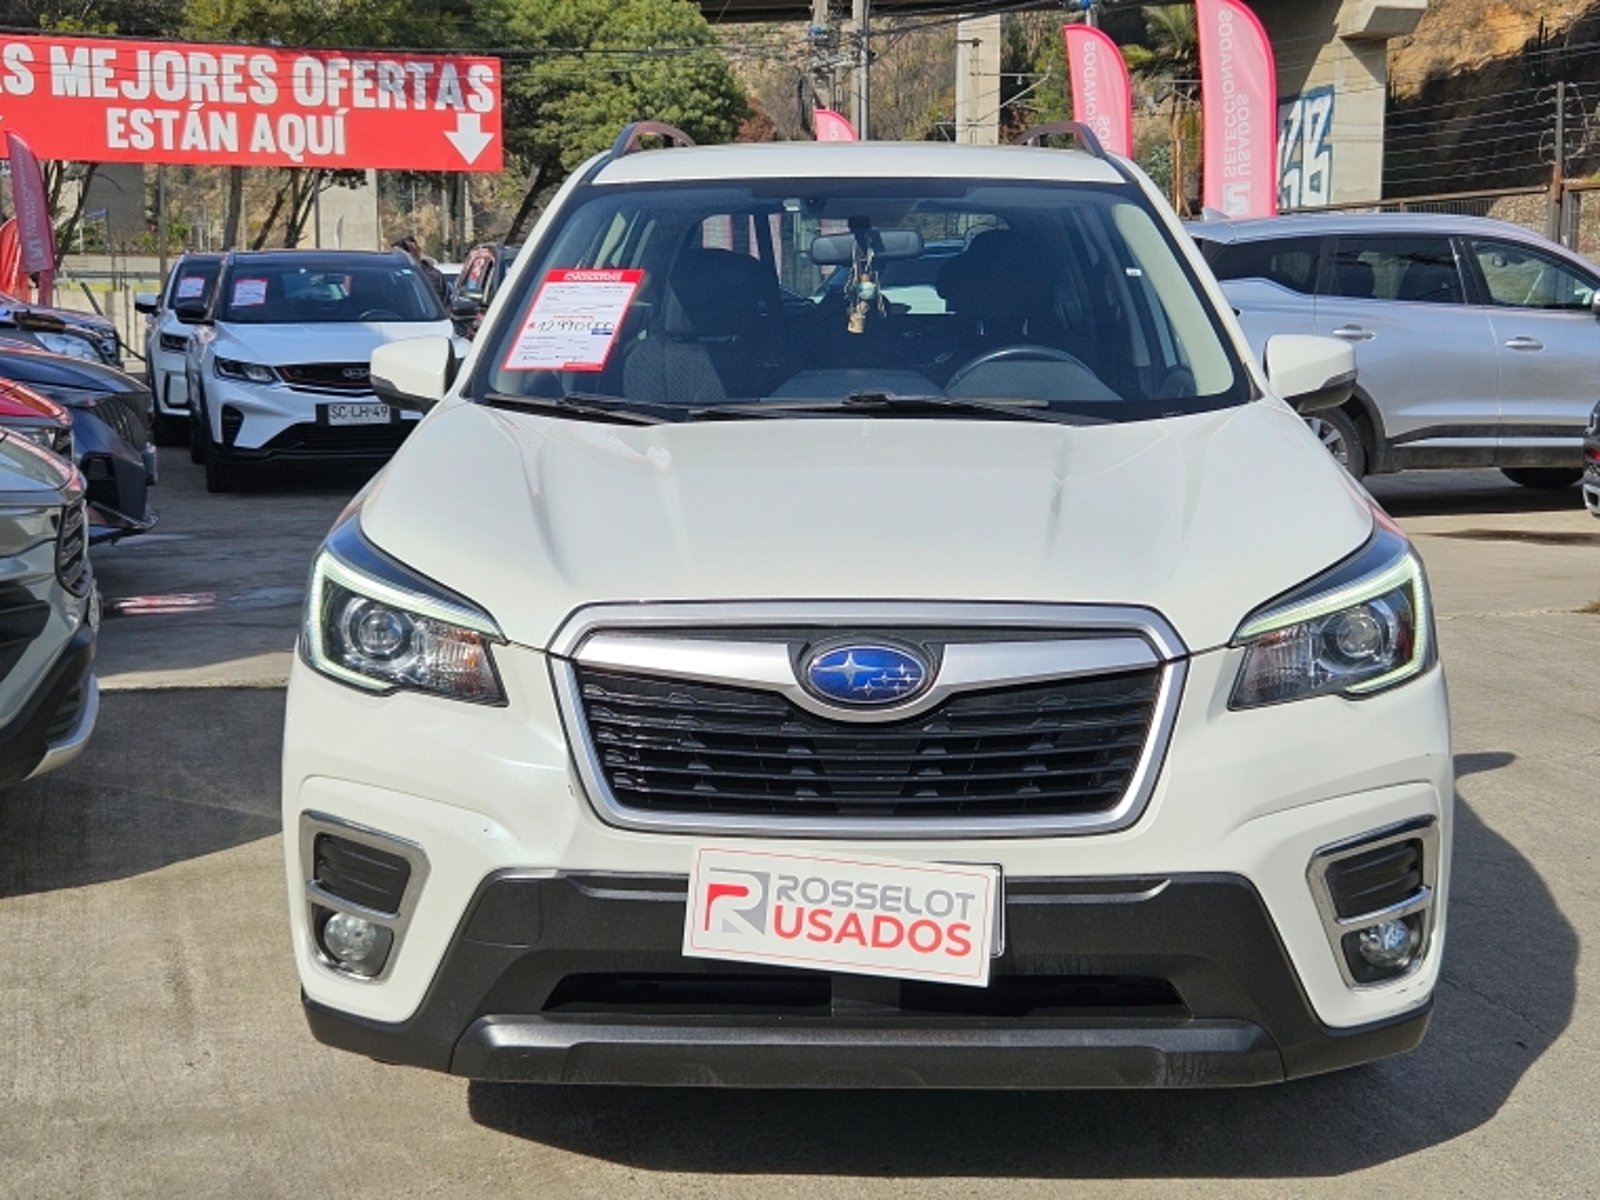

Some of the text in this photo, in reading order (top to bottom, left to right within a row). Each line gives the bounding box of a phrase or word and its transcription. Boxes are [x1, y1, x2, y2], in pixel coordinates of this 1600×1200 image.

[0, 43, 495, 113] S MEJORES OFERTAS
[106, 102, 347, 163] ESTÁN AQUÍ
[776, 874, 976, 921] ROSSELOT
[772, 904, 973, 958] USADOS
